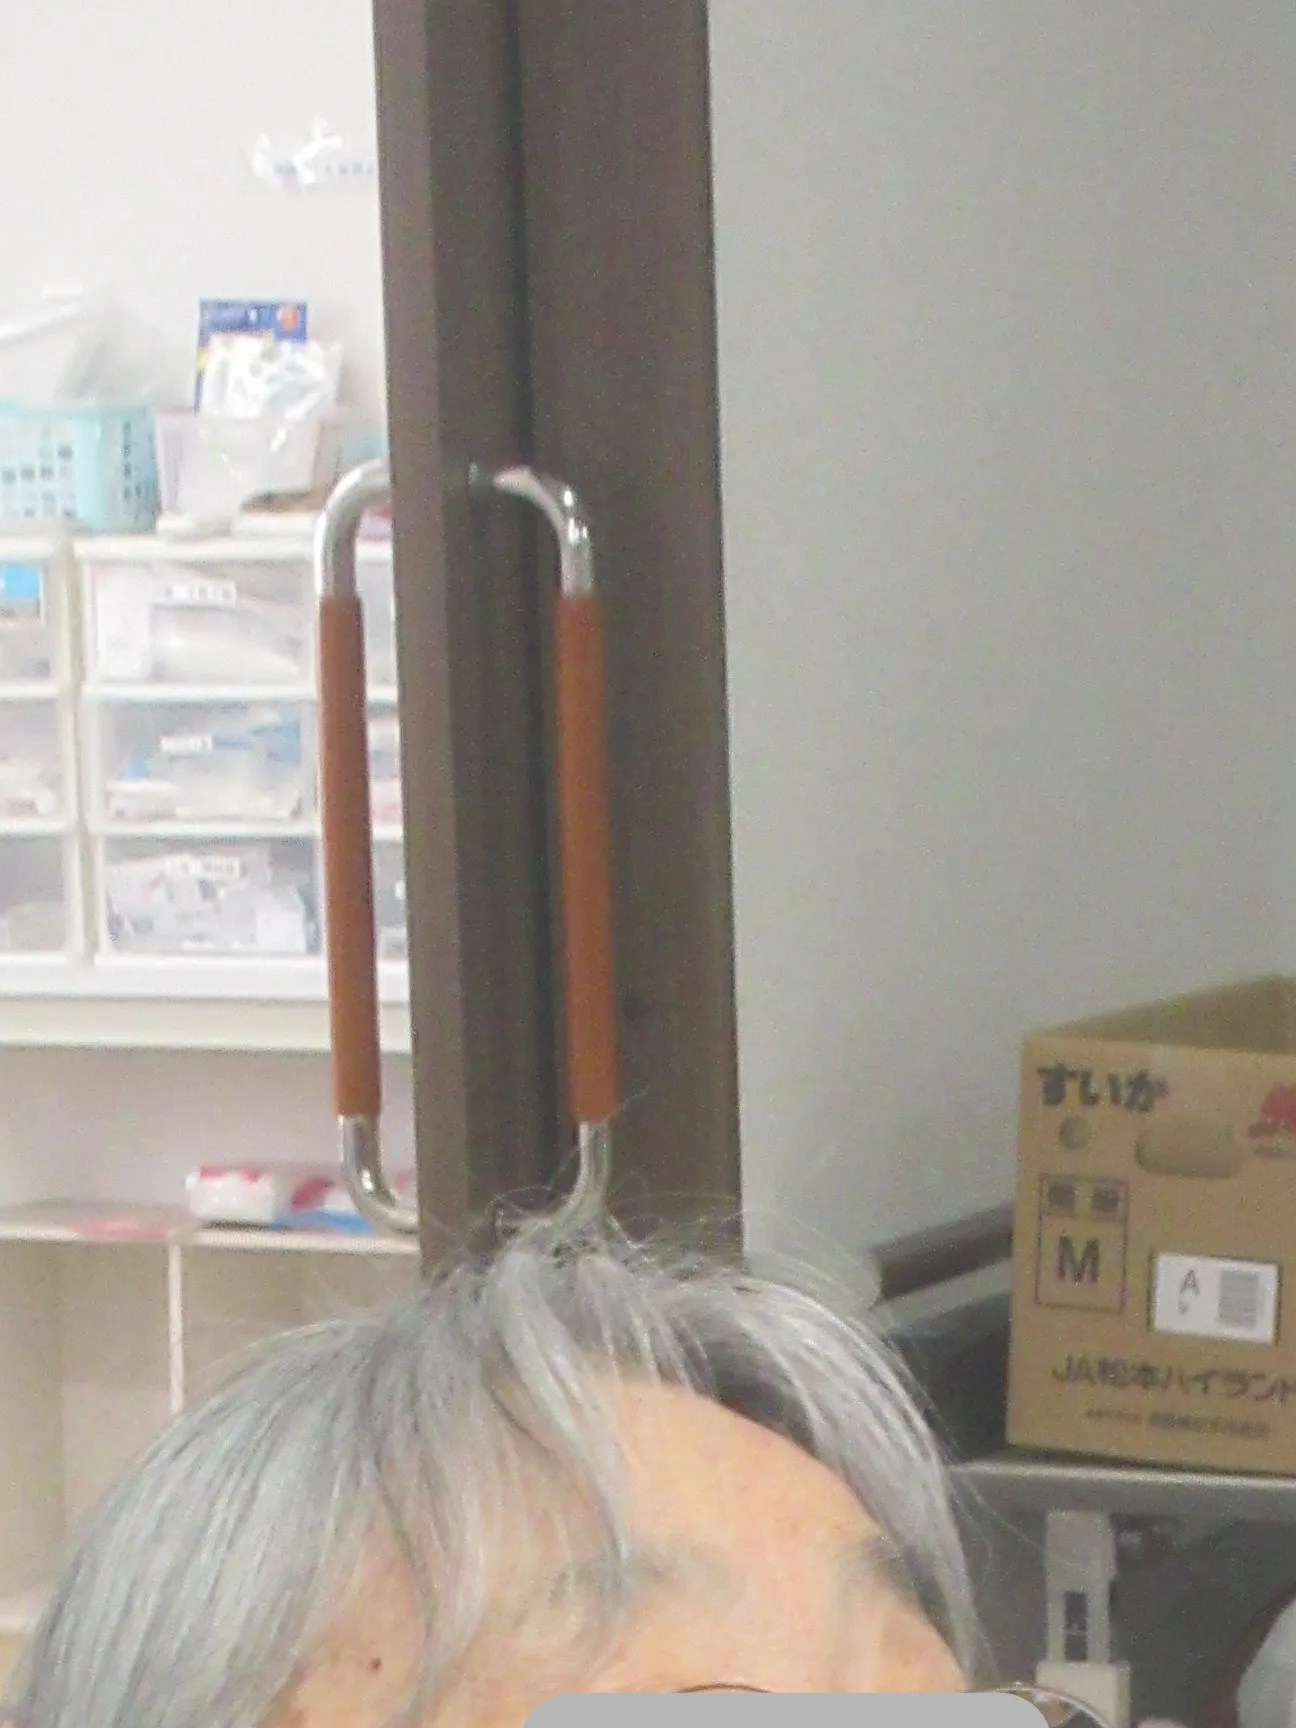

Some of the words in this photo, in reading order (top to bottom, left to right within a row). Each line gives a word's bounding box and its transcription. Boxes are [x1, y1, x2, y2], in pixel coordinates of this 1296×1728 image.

[1037, 1063, 1169, 1114] すいか
[1058, 1236, 1100, 1284] M
[1181, 1269, 1200, 1296] A
